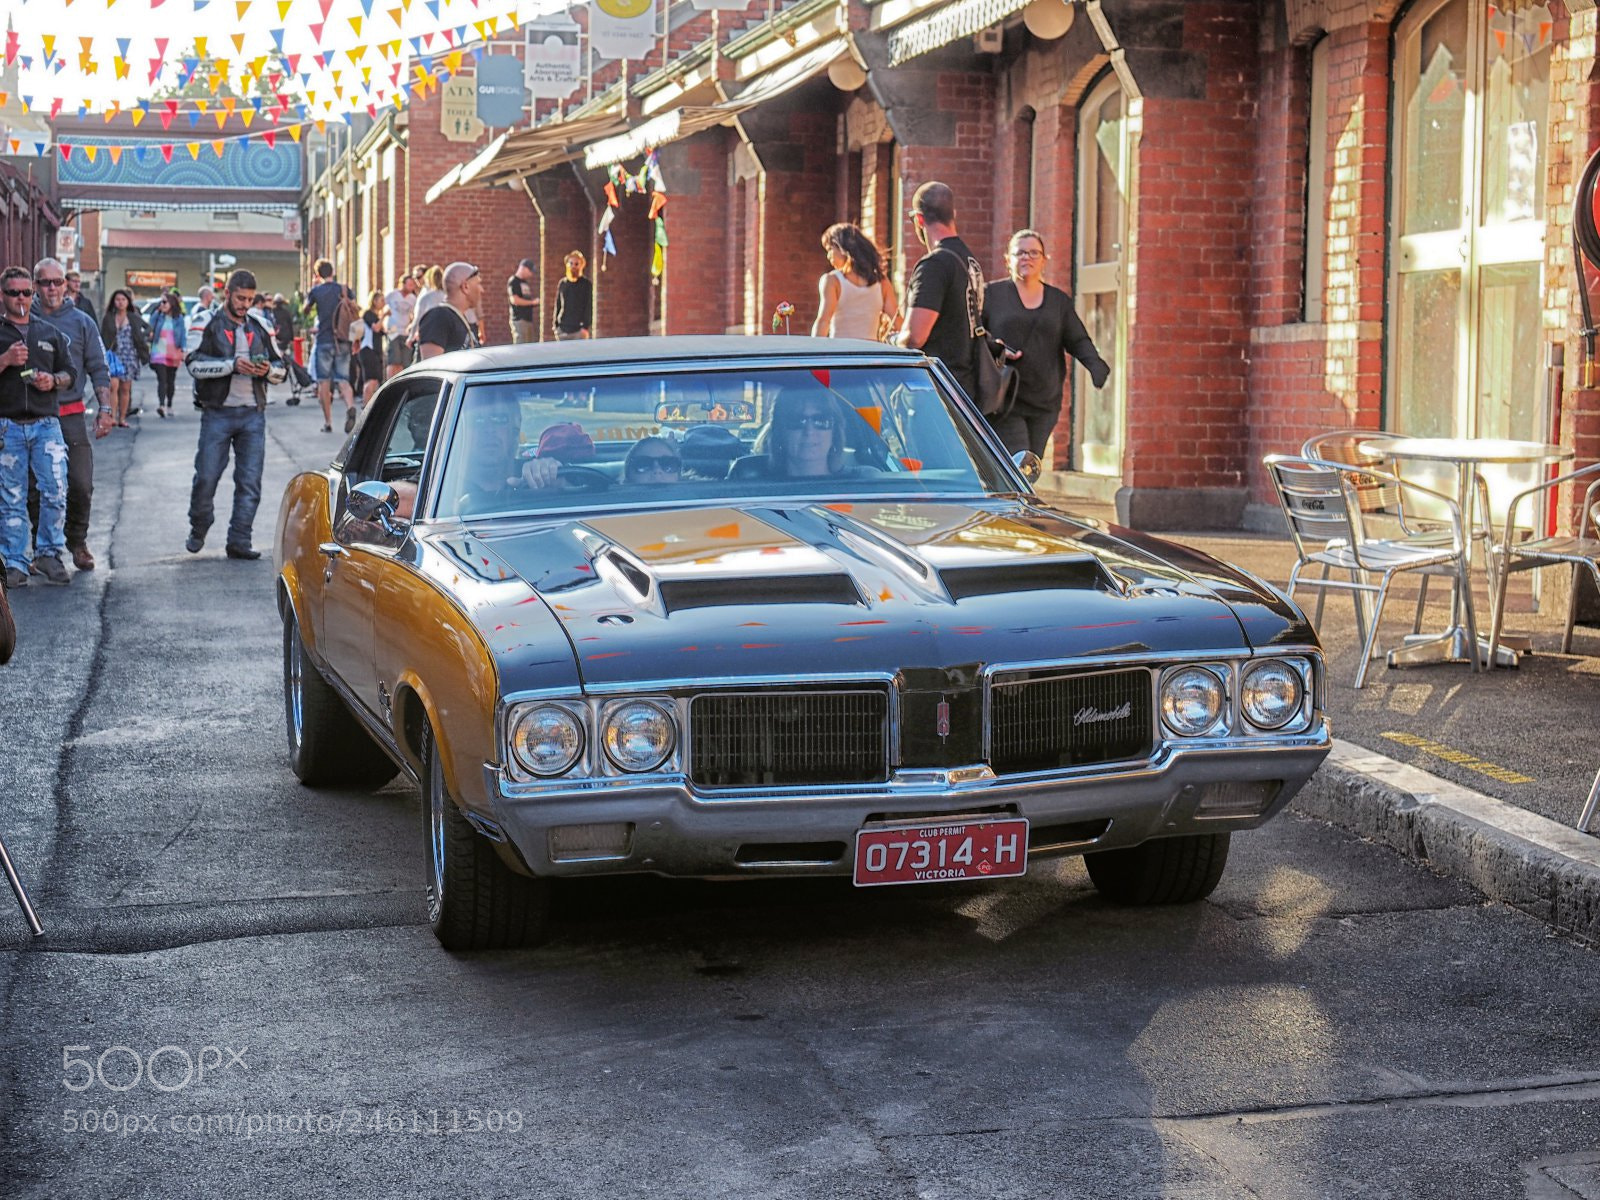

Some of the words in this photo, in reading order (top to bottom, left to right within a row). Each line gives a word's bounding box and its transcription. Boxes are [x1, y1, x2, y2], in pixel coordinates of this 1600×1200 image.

[534, 69, 573, 77] Aboriginal
[919, 828, 938, 838] CLUB
[939, 826, 966, 837] PERMIT
[915, 868, 966, 880] VICTORIA
